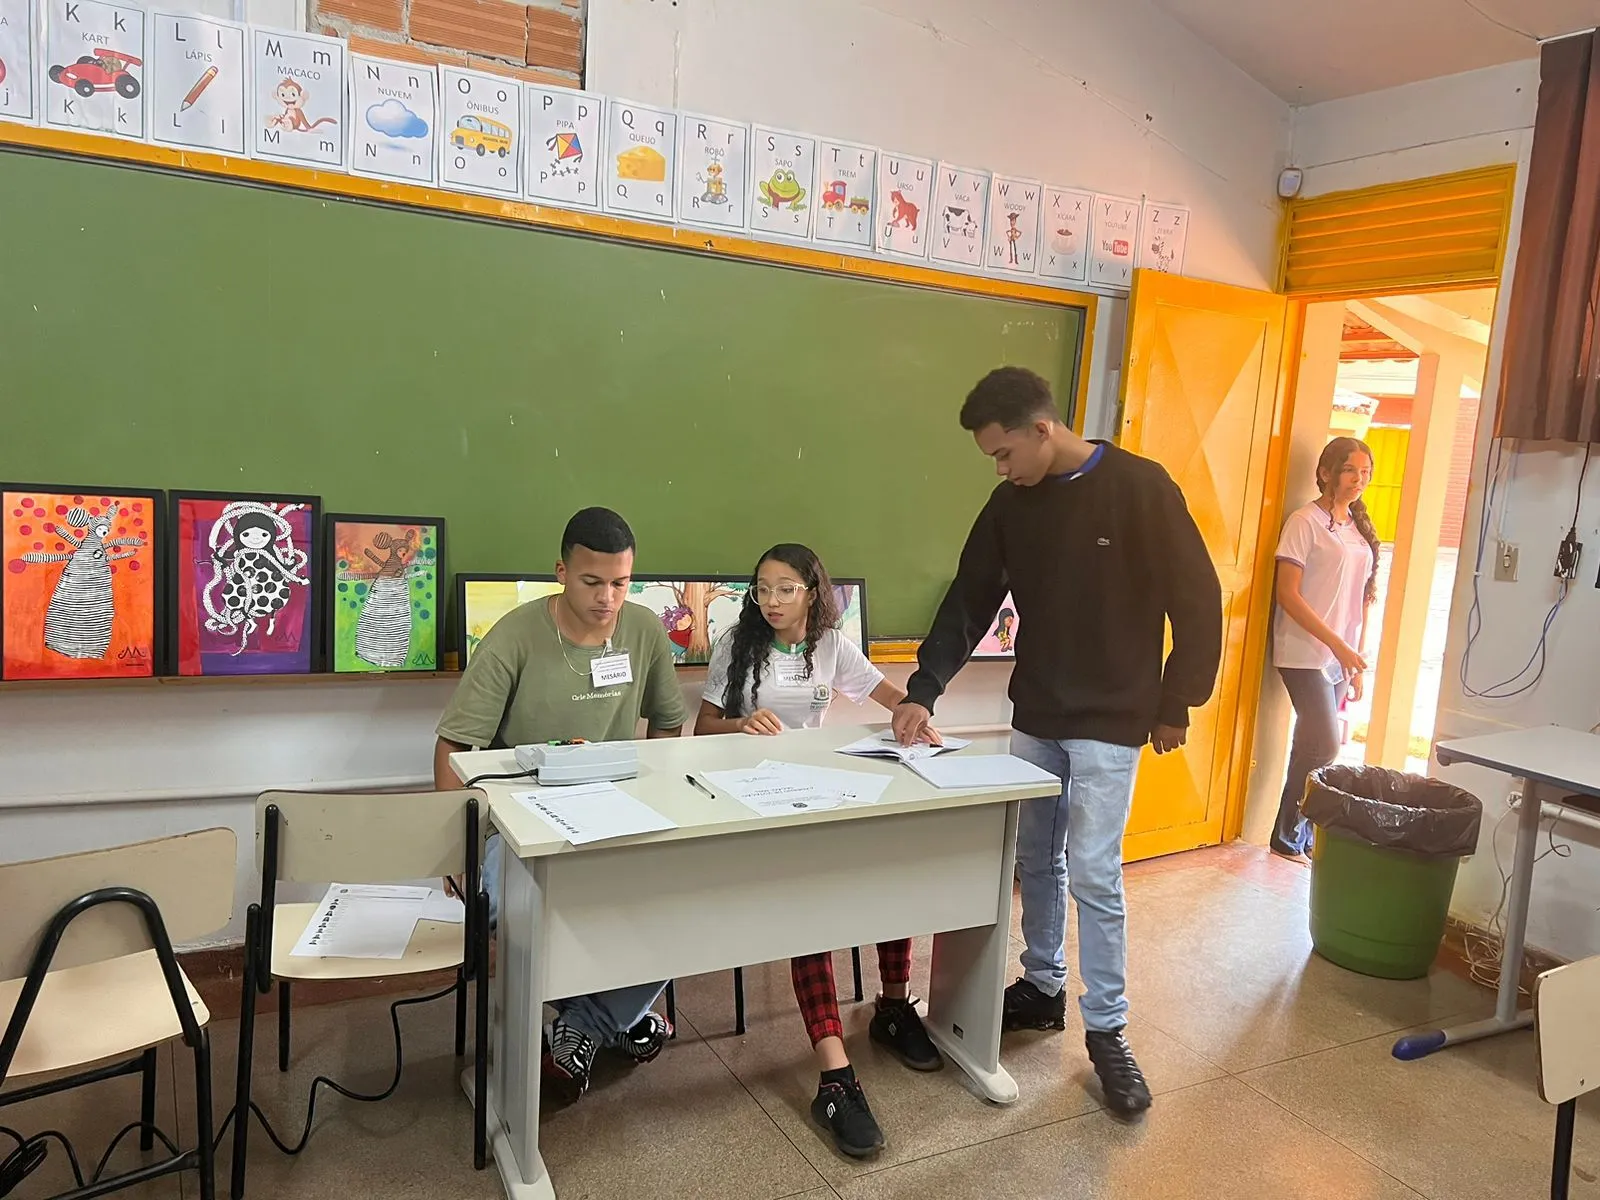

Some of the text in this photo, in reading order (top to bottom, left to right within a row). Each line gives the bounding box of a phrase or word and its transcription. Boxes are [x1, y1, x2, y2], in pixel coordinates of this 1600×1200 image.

[66, 3, 126, 31] K k
[82, 32, 109, 45] KART
[175, 23, 186, 42] L
[185, 49, 213, 63] LÁPIS
[266, 40, 330, 66] M m
[277, 65, 321, 80] MACACO
[367, 65, 419, 88] N n
[4, 88, 9, 106] j
[378, 86, 412, 100] NUVEM
[458, 78, 507, 102] O o
[64, 99, 128, 124] K k
[467, 100, 499, 115] ÔNIBUS
[543, 96, 588, 120] P p
[173, 113, 181, 128] L
[556, 119, 575, 129] PIPA
[622, 110, 665, 136] Q q
[264, 129, 334, 152] M m
[697, 124, 734, 145] R r
[366, 143, 421, 165] N n
[704, 146, 725, 157] ROBÔ
[767, 136, 802, 156] S s
[454, 156, 507, 177] O o
[774, 158, 793, 168] SAPO
[831, 148, 865, 168] T t
[838, 169, 857, 179] TREM
[890, 161, 924, 181] U u
[897, 182, 914, 192] URSO
[949, 174, 980, 192] V v
[617, 184, 664, 206] Q q
[955, 193, 970, 202] VACA
[998, 184, 1035, 201] W w
[1053, 194, 1061, 208] X
[692, 196, 734, 213] R r
[1004, 202, 1026, 211] WOODY
[1104, 204, 1131, 222] Y y
[762, 206, 799, 223] S s
[1152, 210, 1180, 226] Z z
[826, 217, 862, 232] T t
[885, 225, 918, 244] U u
[943, 238, 974, 253] V v
[993, 246, 1032, 261] W w
[1049, 255, 1055, 266] X
[1121, 268, 1127, 279] y
